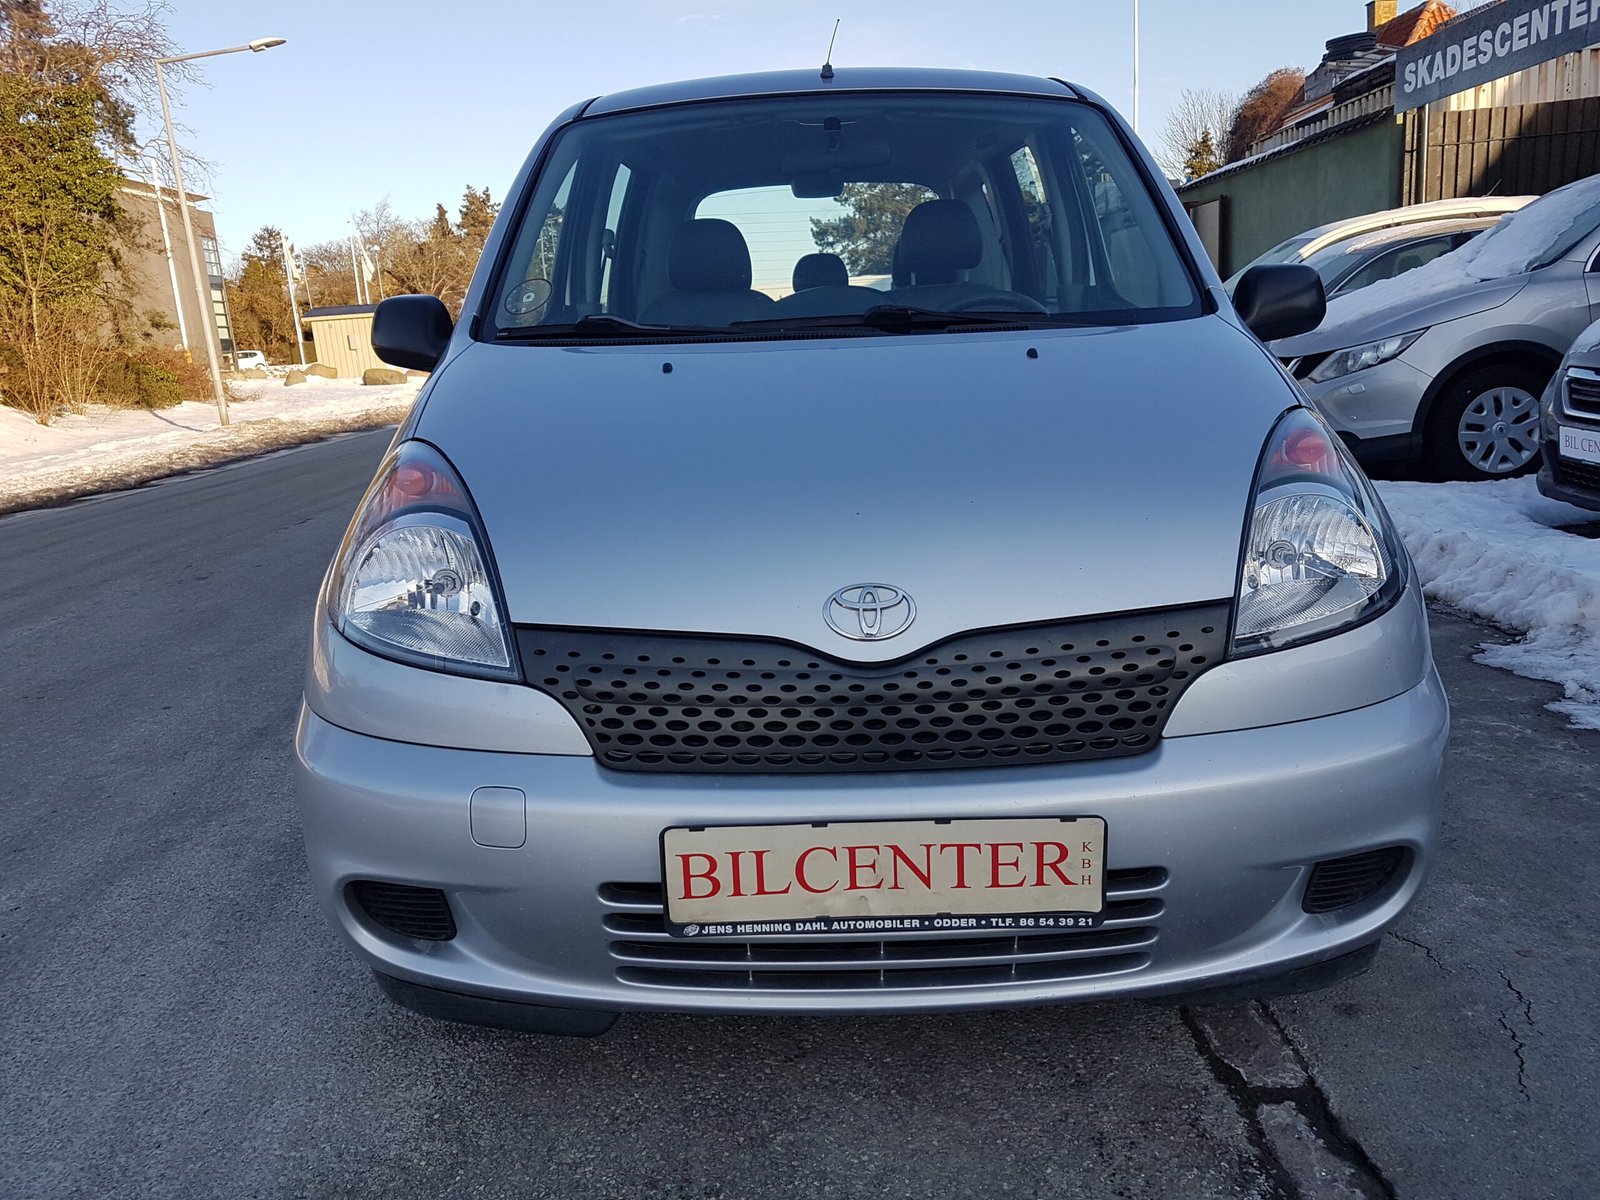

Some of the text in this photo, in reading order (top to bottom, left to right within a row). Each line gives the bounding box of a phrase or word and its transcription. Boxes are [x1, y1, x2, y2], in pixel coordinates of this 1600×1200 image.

[675, 841, 1079, 900] BILCENTER
[702, 918, 1093, 934] JENS HENNING DAHL AUTOMOBILER ODDER TLF. 86 54 39 21
